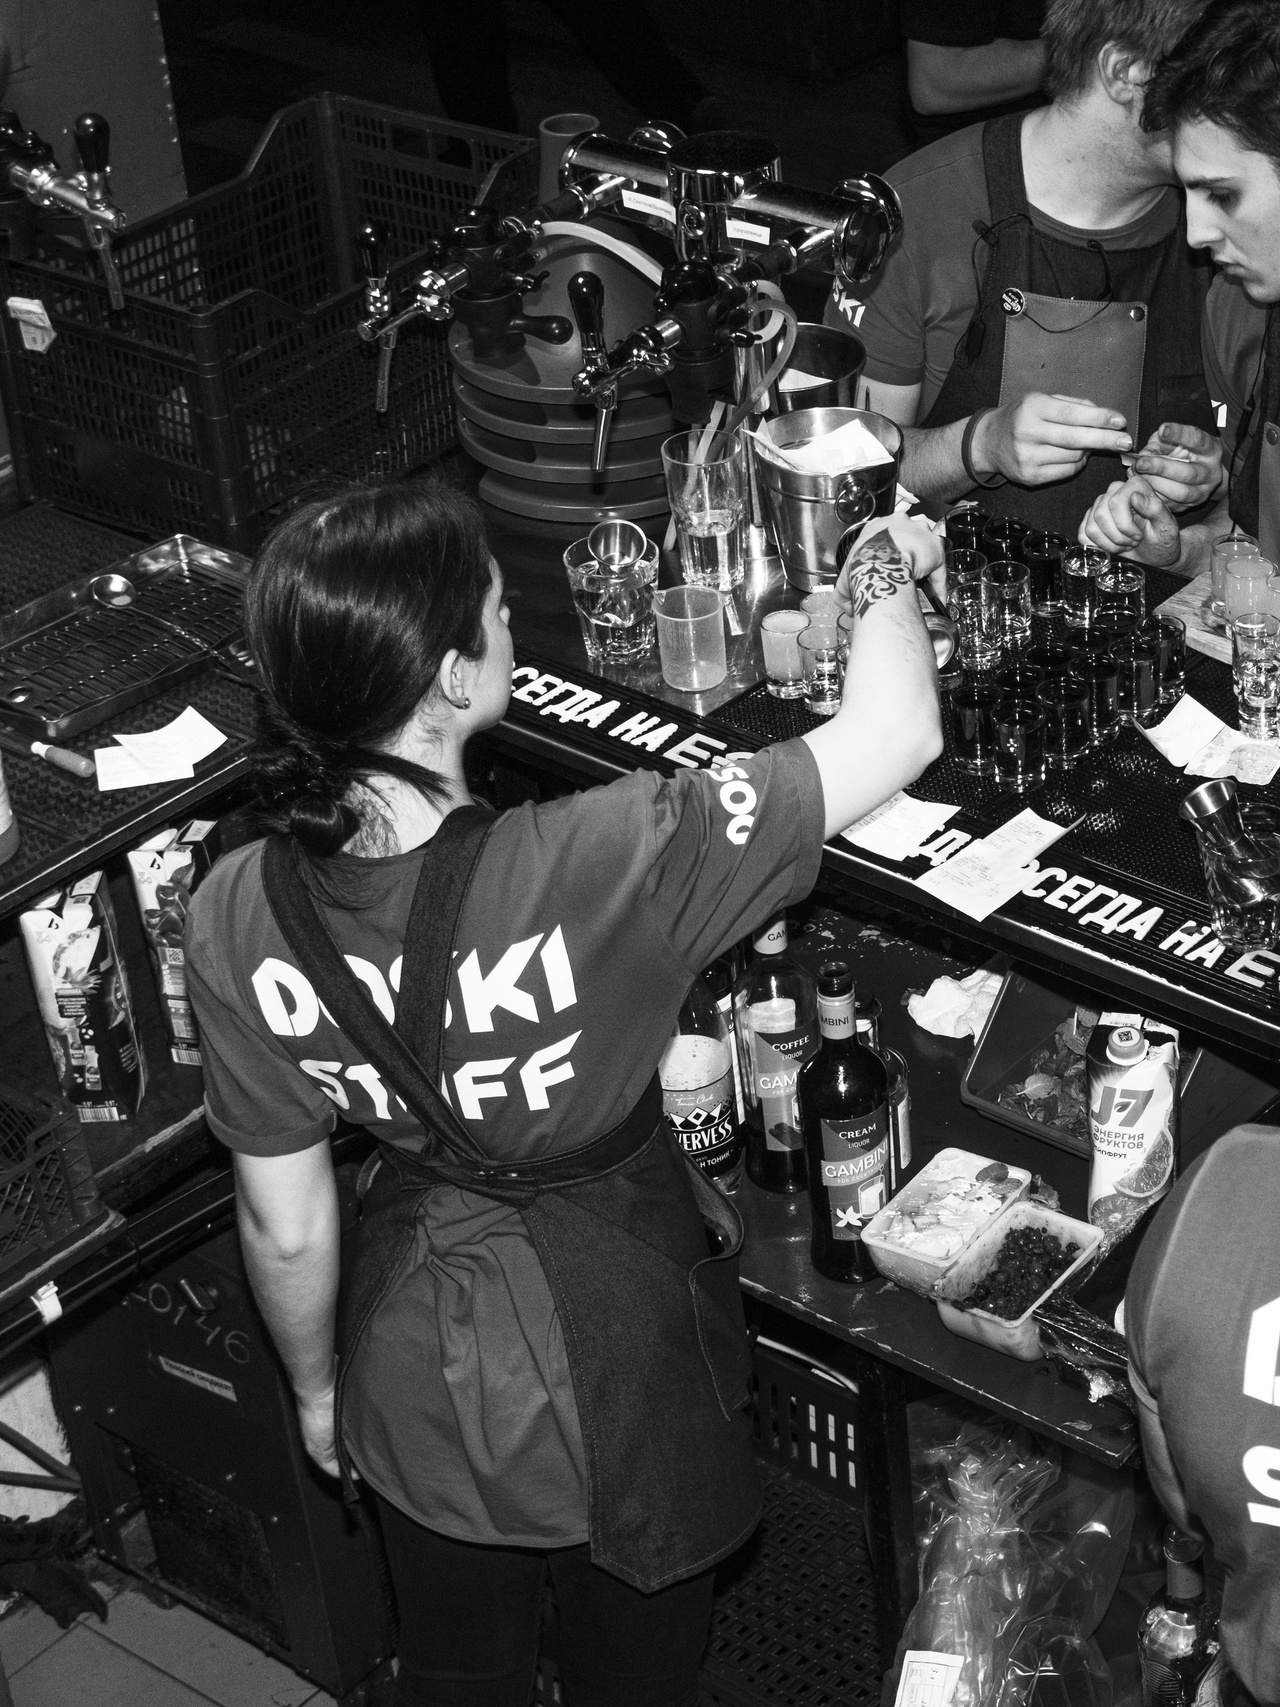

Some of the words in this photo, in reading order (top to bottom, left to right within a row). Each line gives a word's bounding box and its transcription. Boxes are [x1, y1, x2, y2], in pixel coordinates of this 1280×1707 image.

[832, 275, 866, 328] SKI
[512, 661, 621, 728] СЕГДА
[608, 711, 679, 752] НА
[702, 766, 757, 845] DOS
[1158, 920, 1226, 968] НА
[251, 924, 578, 1036] DKI
[819, 1015, 850, 1027] MBINI
[772, 1034, 810, 1052] COFFEE
[781, 1049, 804, 1061] LIQUOR
[299, 1029, 583, 1119] STFF
[674, 1117, 733, 1152] ERVESS
[838, 1122, 877, 1140] CREAM
[848, 1138, 870, 1149] LIQUOR
[1093, 1125, 1145, 1142] ЭНЕРГИЯ
[1093, 1133, 1144, 1149] ФРУКТОВ
[824, 1139, 888, 1178] GAMBINI
[1093, 1145, 1127, 1159] ЙПФРУТ
